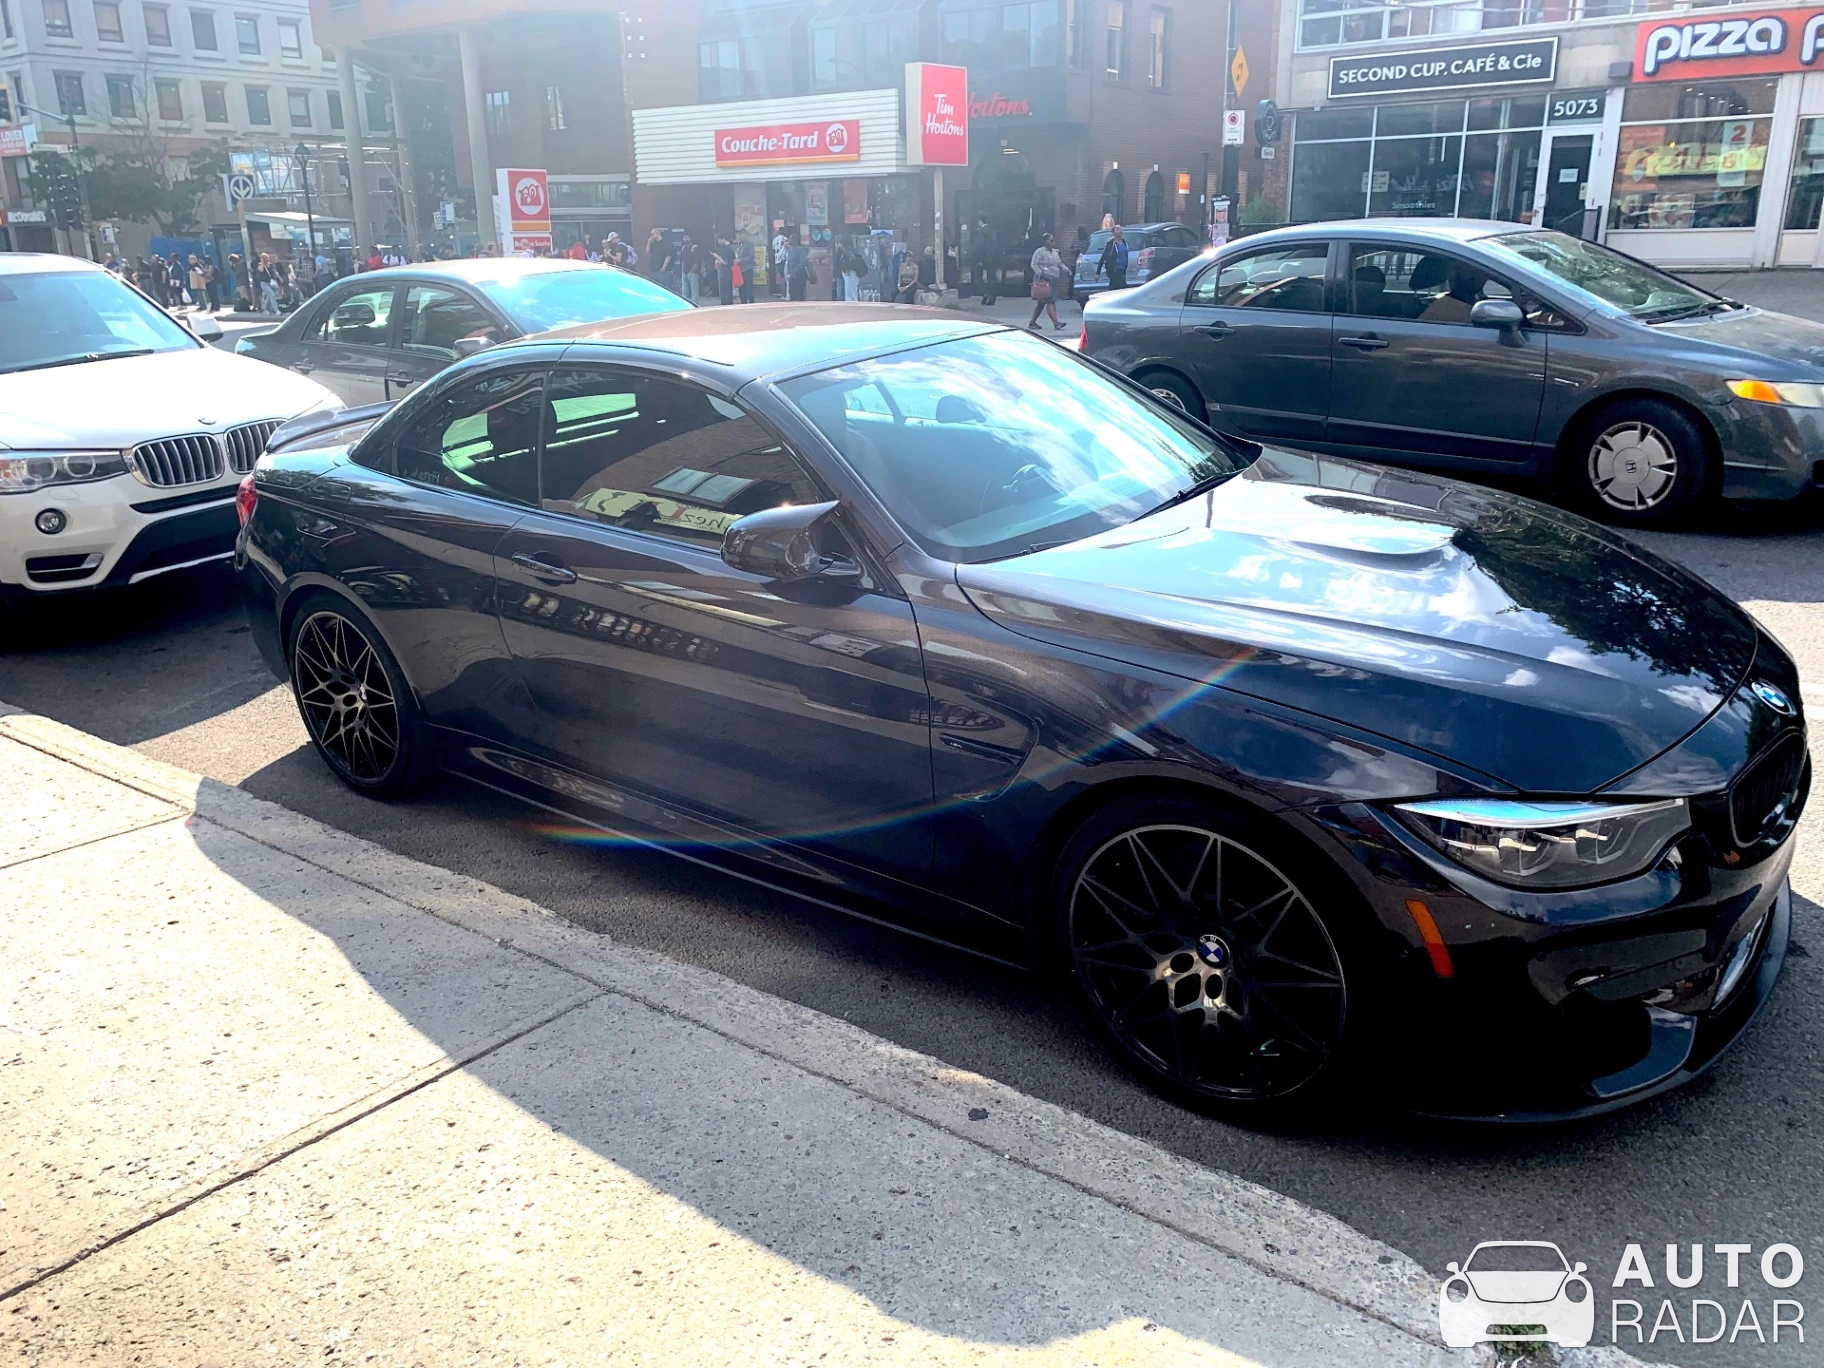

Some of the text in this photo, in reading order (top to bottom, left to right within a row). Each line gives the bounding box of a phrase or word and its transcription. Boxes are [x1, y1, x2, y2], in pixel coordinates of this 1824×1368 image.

[1338, 65, 1407, 84] SECOND
[1450, 53, 1496, 75] CAFÉ
[1497, 56, 1511, 71] &
[1513, 53, 1542, 69] Cie
[934, 93, 954, 116] Tim
[1553, 98, 1598, 117] 5073
[925, 112, 964, 136] Hortons
[1731, 125, 1747, 142] 2
[721, 131, 819, 154] Couche-Tard
[1391, 201, 1436, 209] Smoothies
